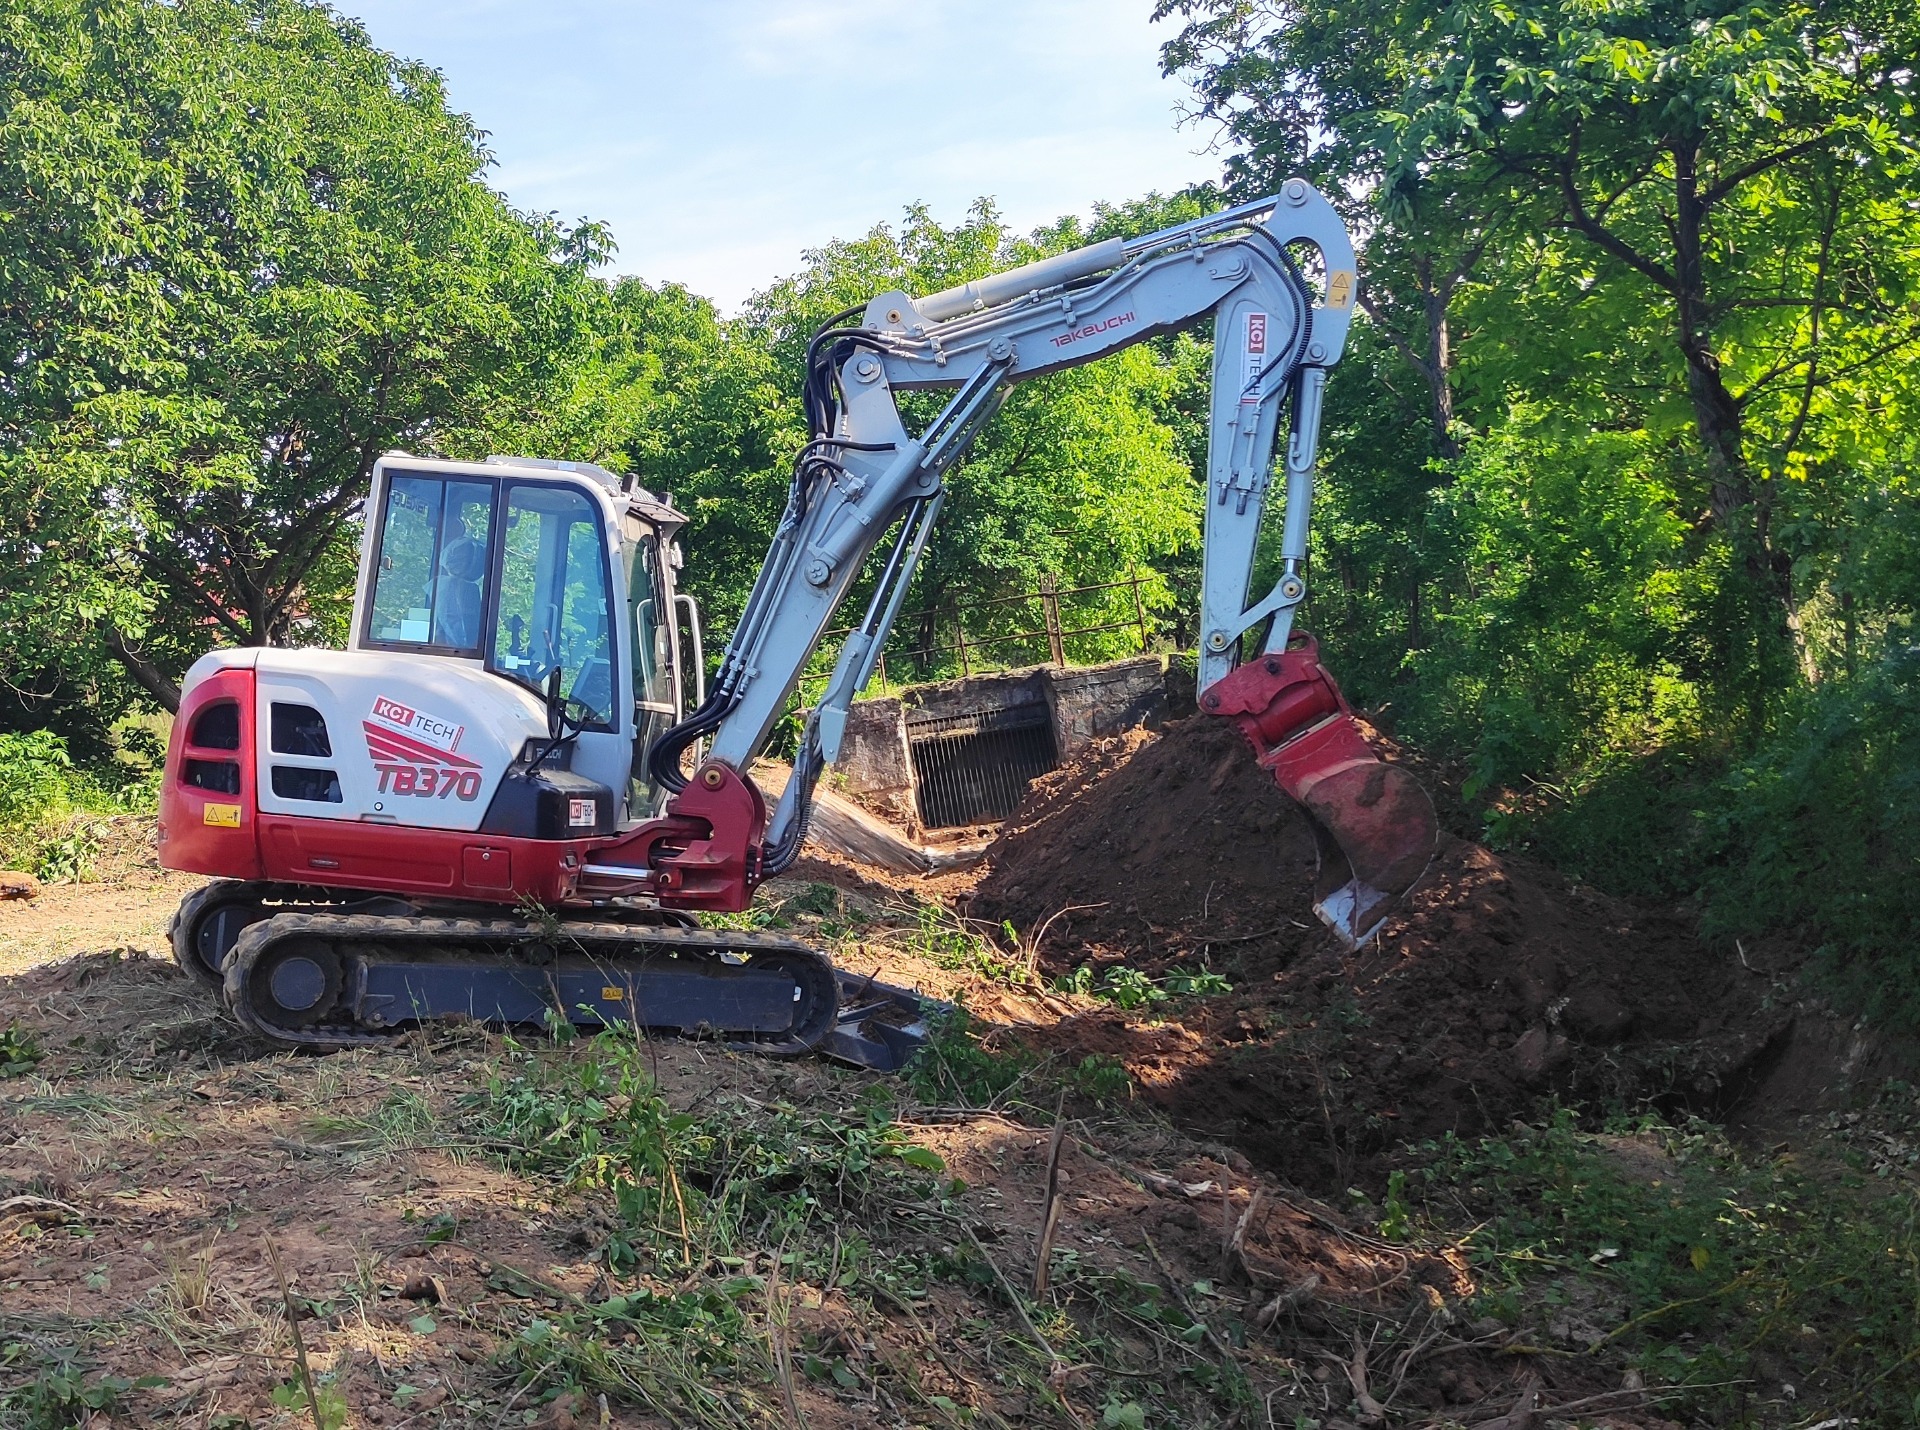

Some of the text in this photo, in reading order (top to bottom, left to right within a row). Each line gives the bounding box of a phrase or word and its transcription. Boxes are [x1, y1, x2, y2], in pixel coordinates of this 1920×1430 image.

[1250, 319, 1264, 350] KCI
[378, 701, 410, 723] KCI
[415, 715, 455, 740] TECH
[374, 764, 482, 801] TB370
